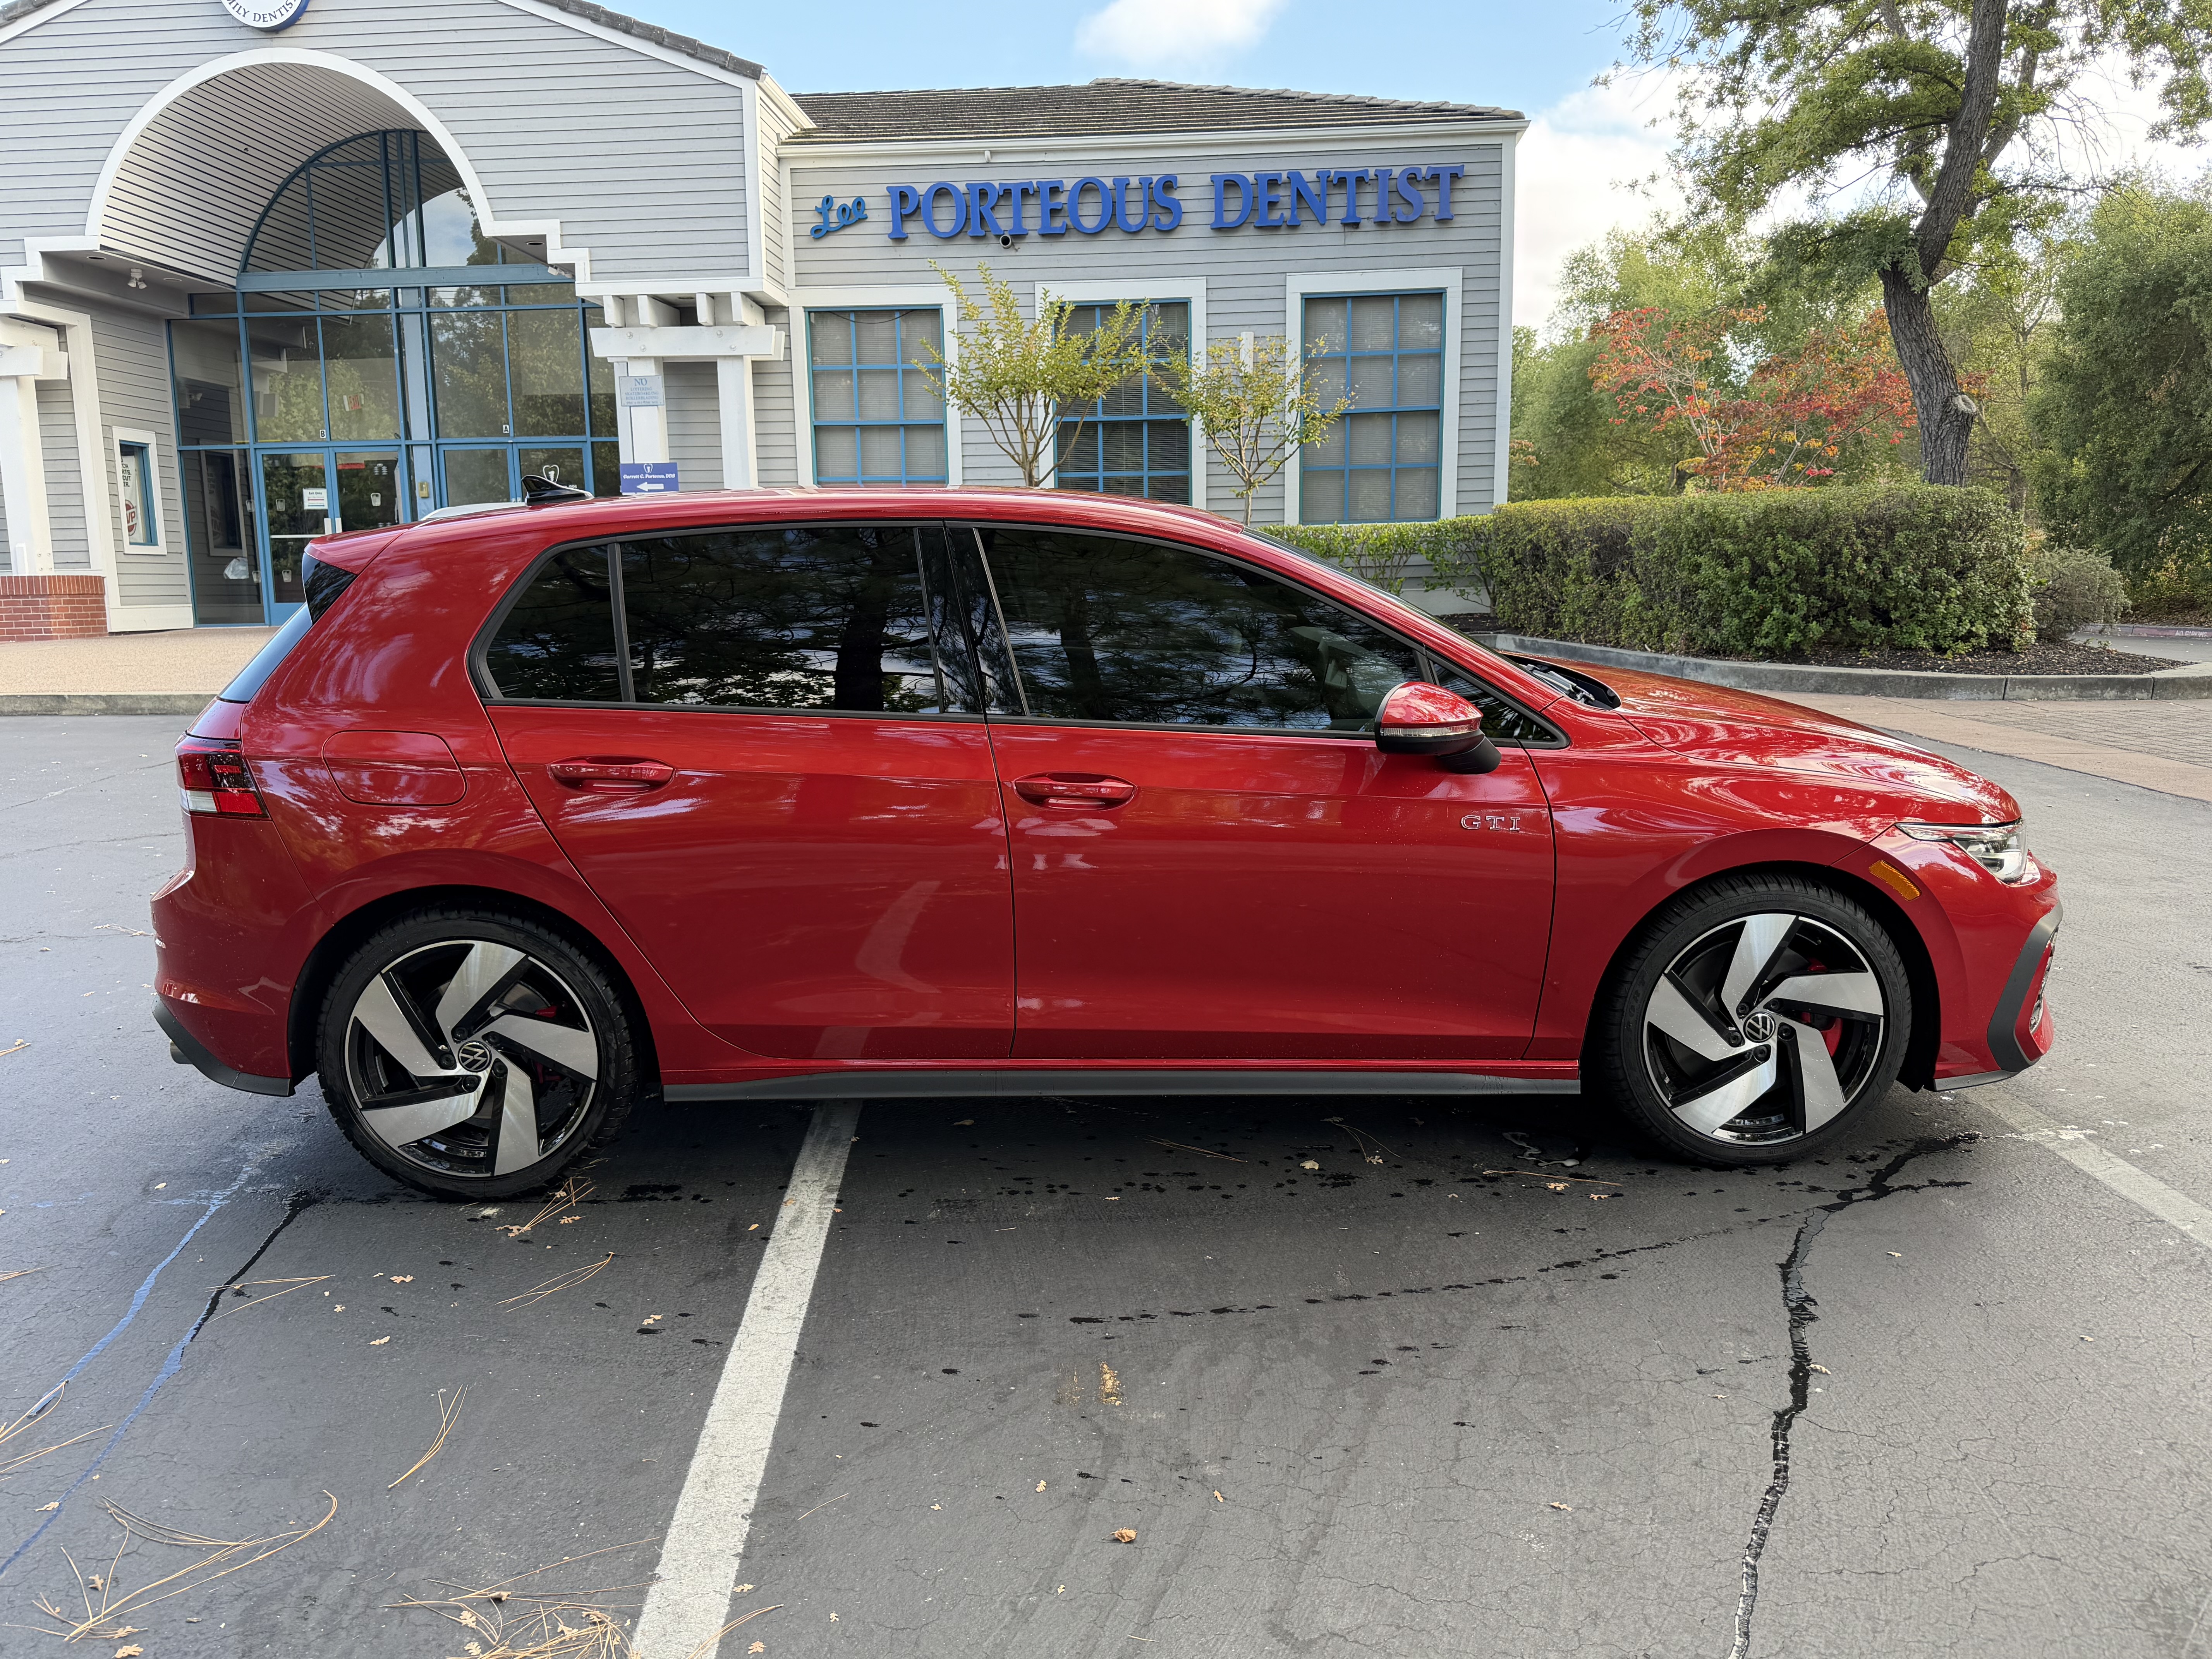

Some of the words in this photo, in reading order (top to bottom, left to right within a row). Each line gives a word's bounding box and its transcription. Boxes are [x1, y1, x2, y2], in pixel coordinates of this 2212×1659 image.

[253, 0, 296, 22] DENTIS
[811, 195, 868, 239] Lee
[887, 175, 1184, 239] PORTEOUS
[1210, 165, 1464, 229] DENTIST
[634, 378, 647, 386] NO
[1461, 815, 1521, 831] GTI
